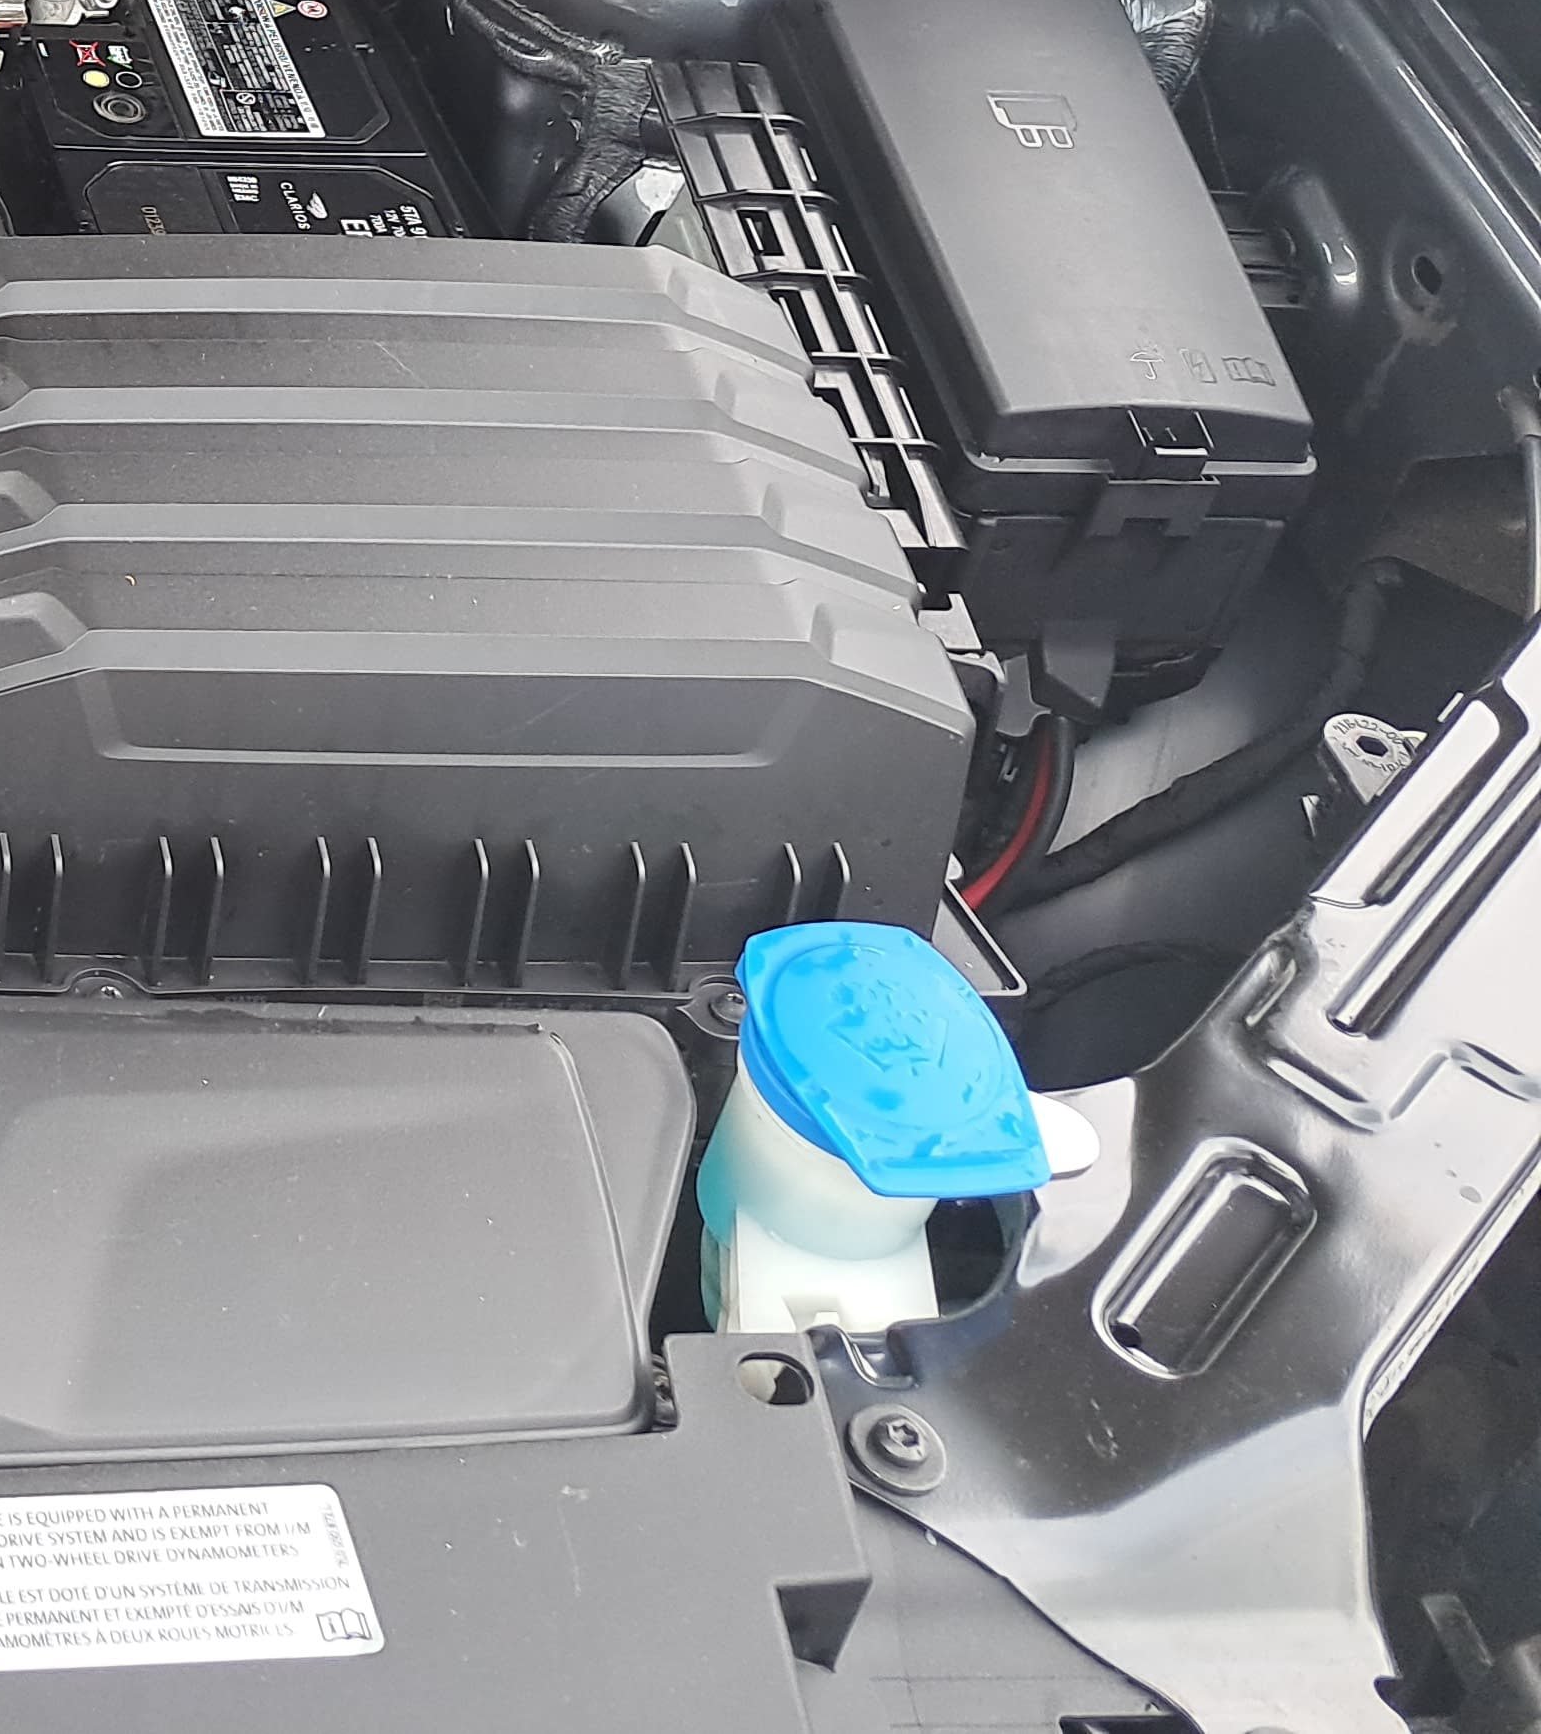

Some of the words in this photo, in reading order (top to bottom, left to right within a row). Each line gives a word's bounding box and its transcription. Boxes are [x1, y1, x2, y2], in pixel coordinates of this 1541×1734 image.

[281, 182, 311, 230] CLARIOS
[7, 1512, 23, 1527] IS
[26, 1508, 107, 1526] EQUIPPED
[109, 1506, 154, 1522] WITH
[172, 1502, 268, 1519] PERMANENT
[47, 1529, 108, 1546] SYSTEM
[112, 1528, 148, 1543] AND
[151, 1527, 166, 1541] IS
[169, 1524, 229, 1540] EXEMPT
[235, 1522, 281, 1537] FROM
[8, 1551, 111, 1569] TWO-WHEEL
[113, 1549, 161, 1565] DRIVE
[18, 1588, 44, 1604] EST
[234, 1576, 350, 1593] TRANSMISSION
[6, 1608, 99, 1626] PERMANENT
[109, 1629, 155, 1645] DEUX
